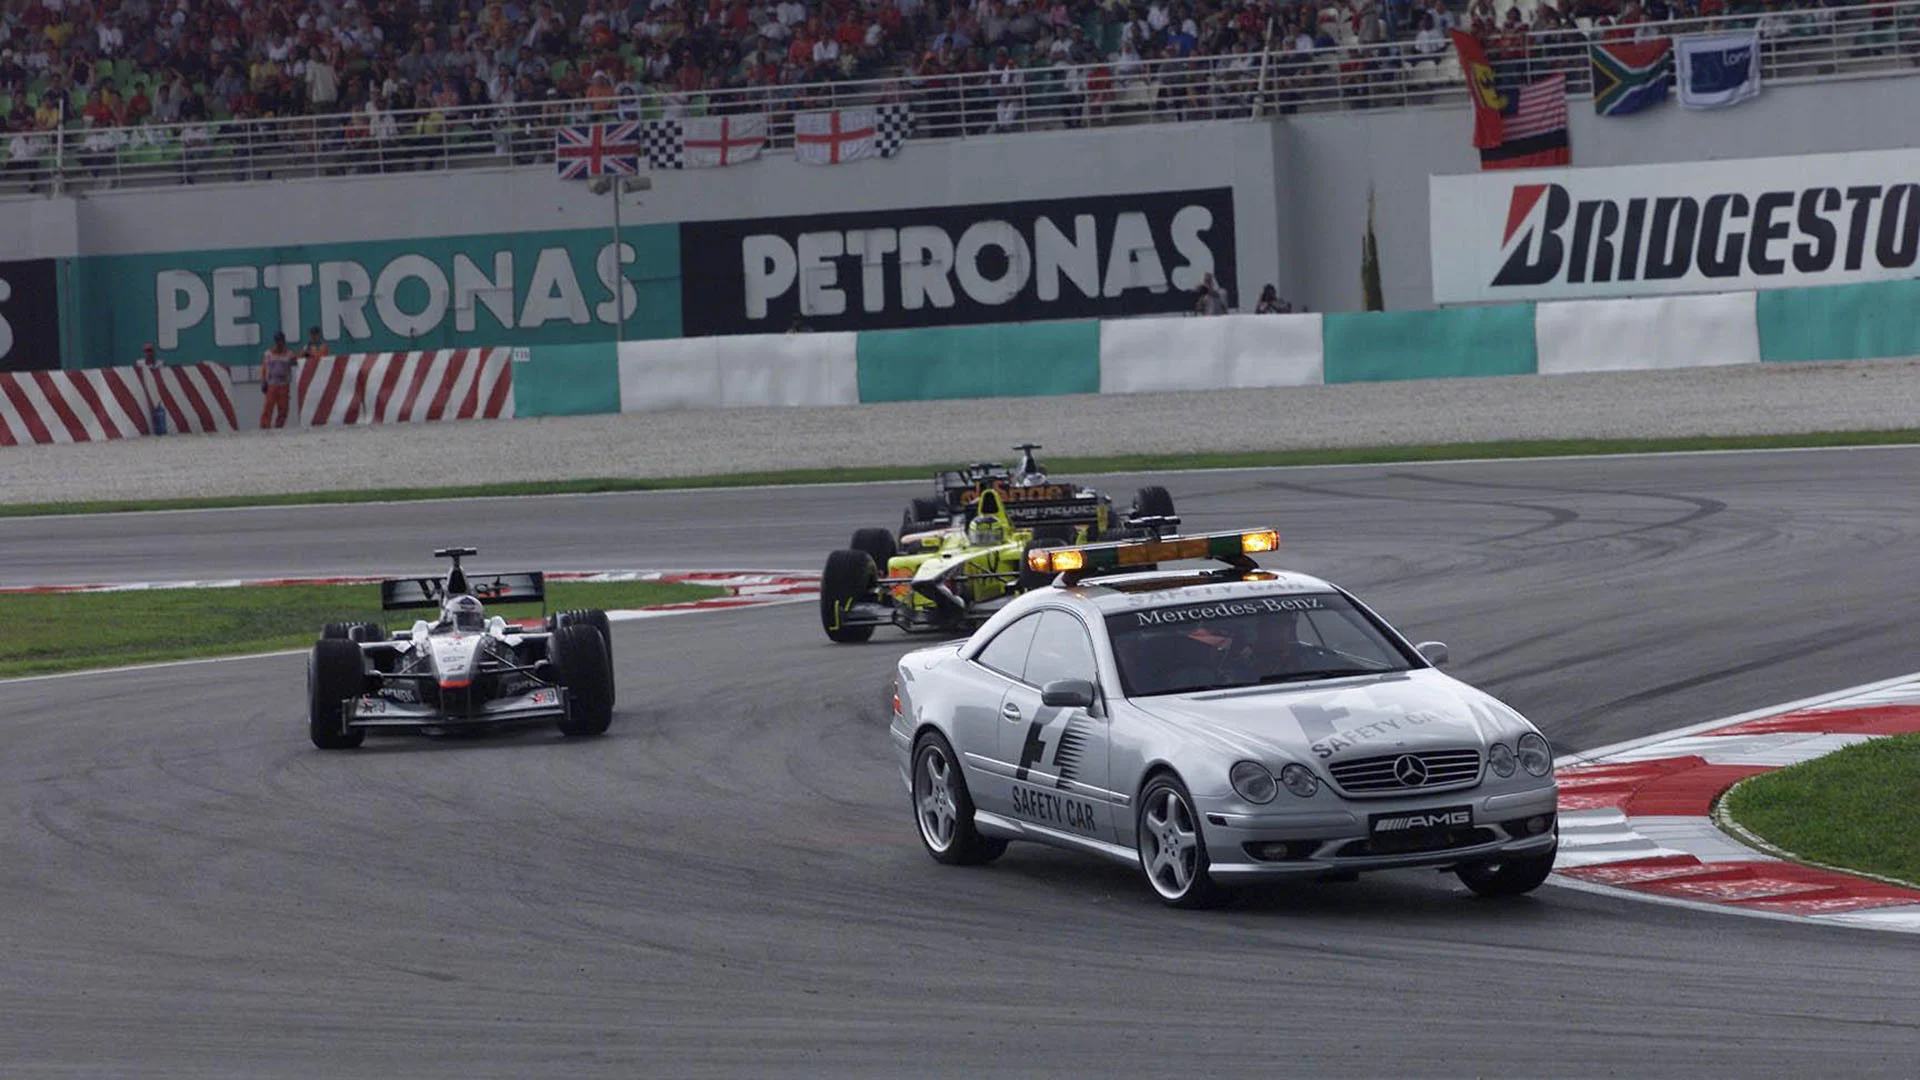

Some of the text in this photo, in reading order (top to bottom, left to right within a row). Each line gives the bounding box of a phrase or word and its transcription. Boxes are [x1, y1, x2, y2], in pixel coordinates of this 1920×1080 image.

[1489, 183, 1920, 286] BRIDGESTO
[742, 204, 1216, 320] PETRONAS
[156, 242, 638, 350] PETRONAS
[1128, 585, 1232, 607] SAFETY
[1137, 597, 1324, 627] Mercedes-Benz
[1312, 719, 1401, 758] SAFETY
[1012, 785, 1097, 831] SAFETY CAR
[1405, 811, 1471, 830] AMG
